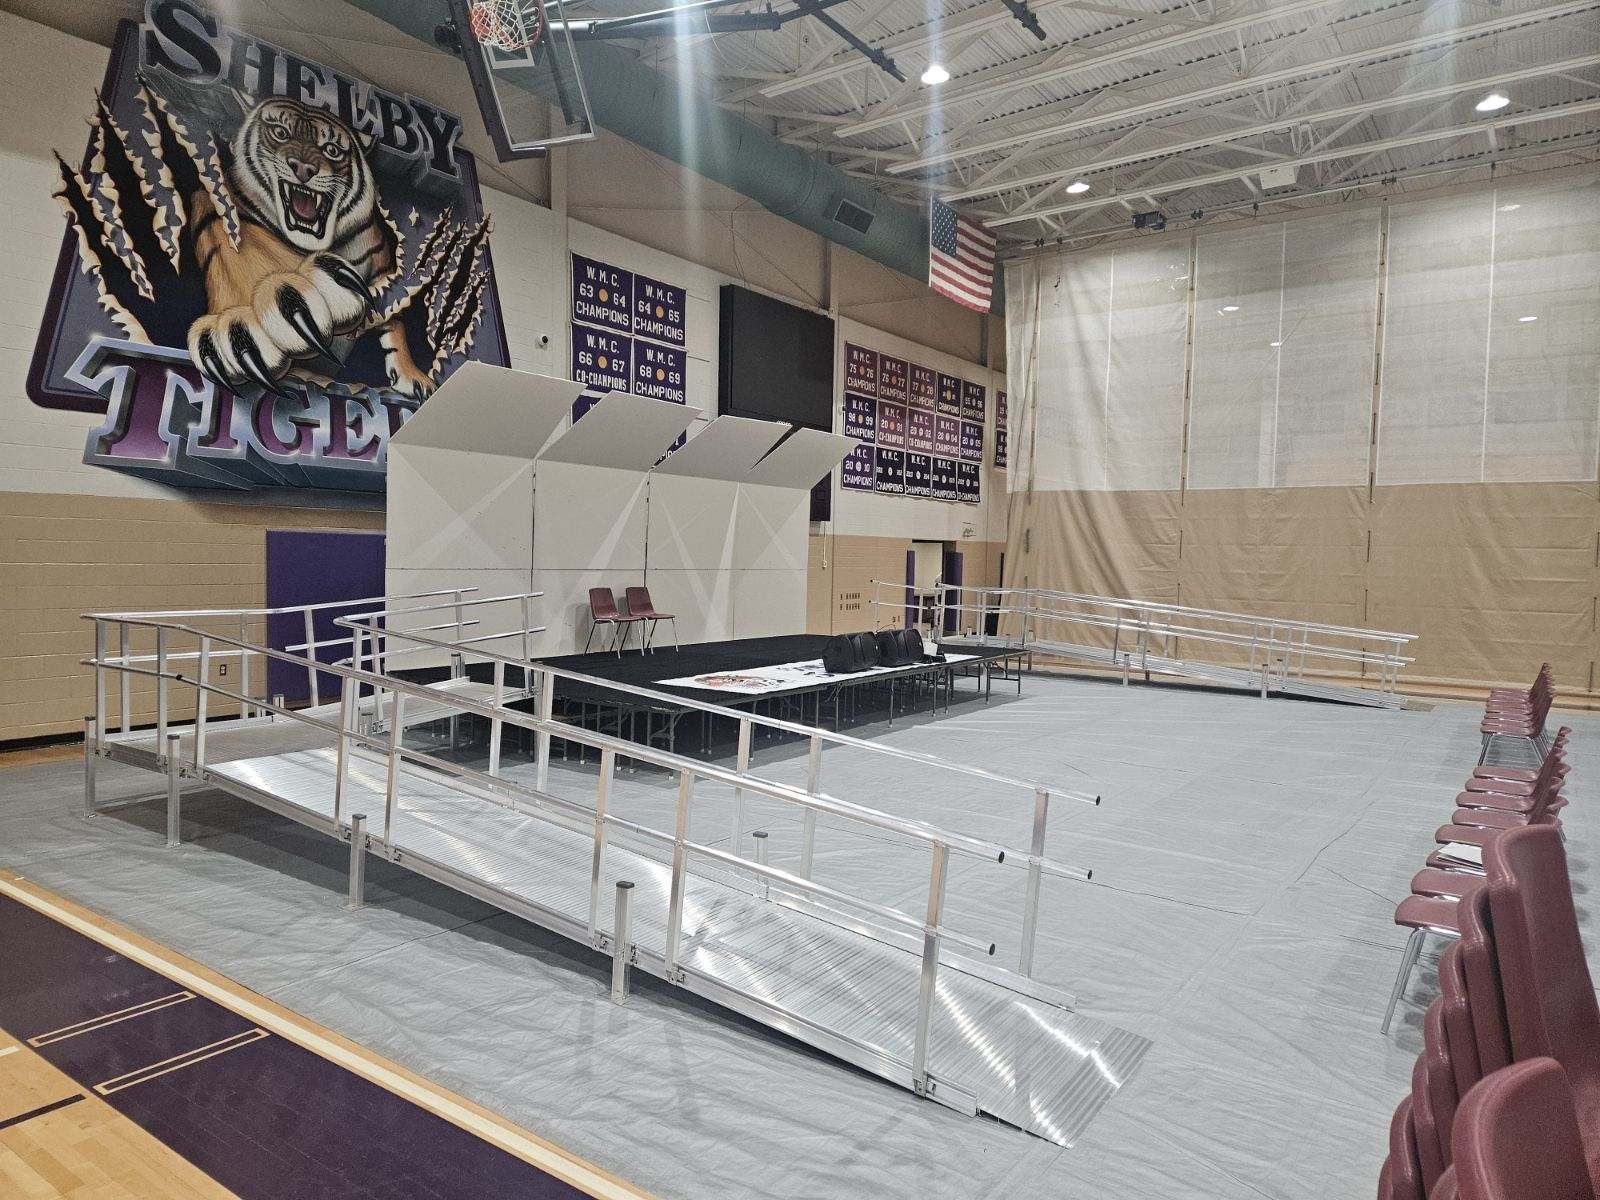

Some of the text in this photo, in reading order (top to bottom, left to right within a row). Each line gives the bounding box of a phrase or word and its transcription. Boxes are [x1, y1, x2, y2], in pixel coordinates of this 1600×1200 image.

[138, 0, 463, 180] SHELBY
[580, 283, 626, 308] 63 64
[576, 301, 629, 326] CHAMPIONS
[638, 300, 680, 322] 64 65
[634, 316, 684, 340] CHAMPIONS
[578, 352, 625, 373] 66 67
[576, 370, 627, 390] CO-CHAMPIONS
[640, 365, 680, 384] 68 69
[636, 381, 684, 402] CHAMPIONS
[848, 377, 876, 392] CHAMPIONS
[880, 386, 906, 400] CHAMPIONS
[866, 416, 874, 426] 99
[880, 420, 888, 428] 20
[846, 425, 874, 438] CHAMPIONS
[846, 460, 870, 472] 20 10
[844, 474, 872, 486] CHAMPIONS
[876, 481, 904, 492] CHAMPIONS
[906, 485, 930, 496] CHAMPIONS
